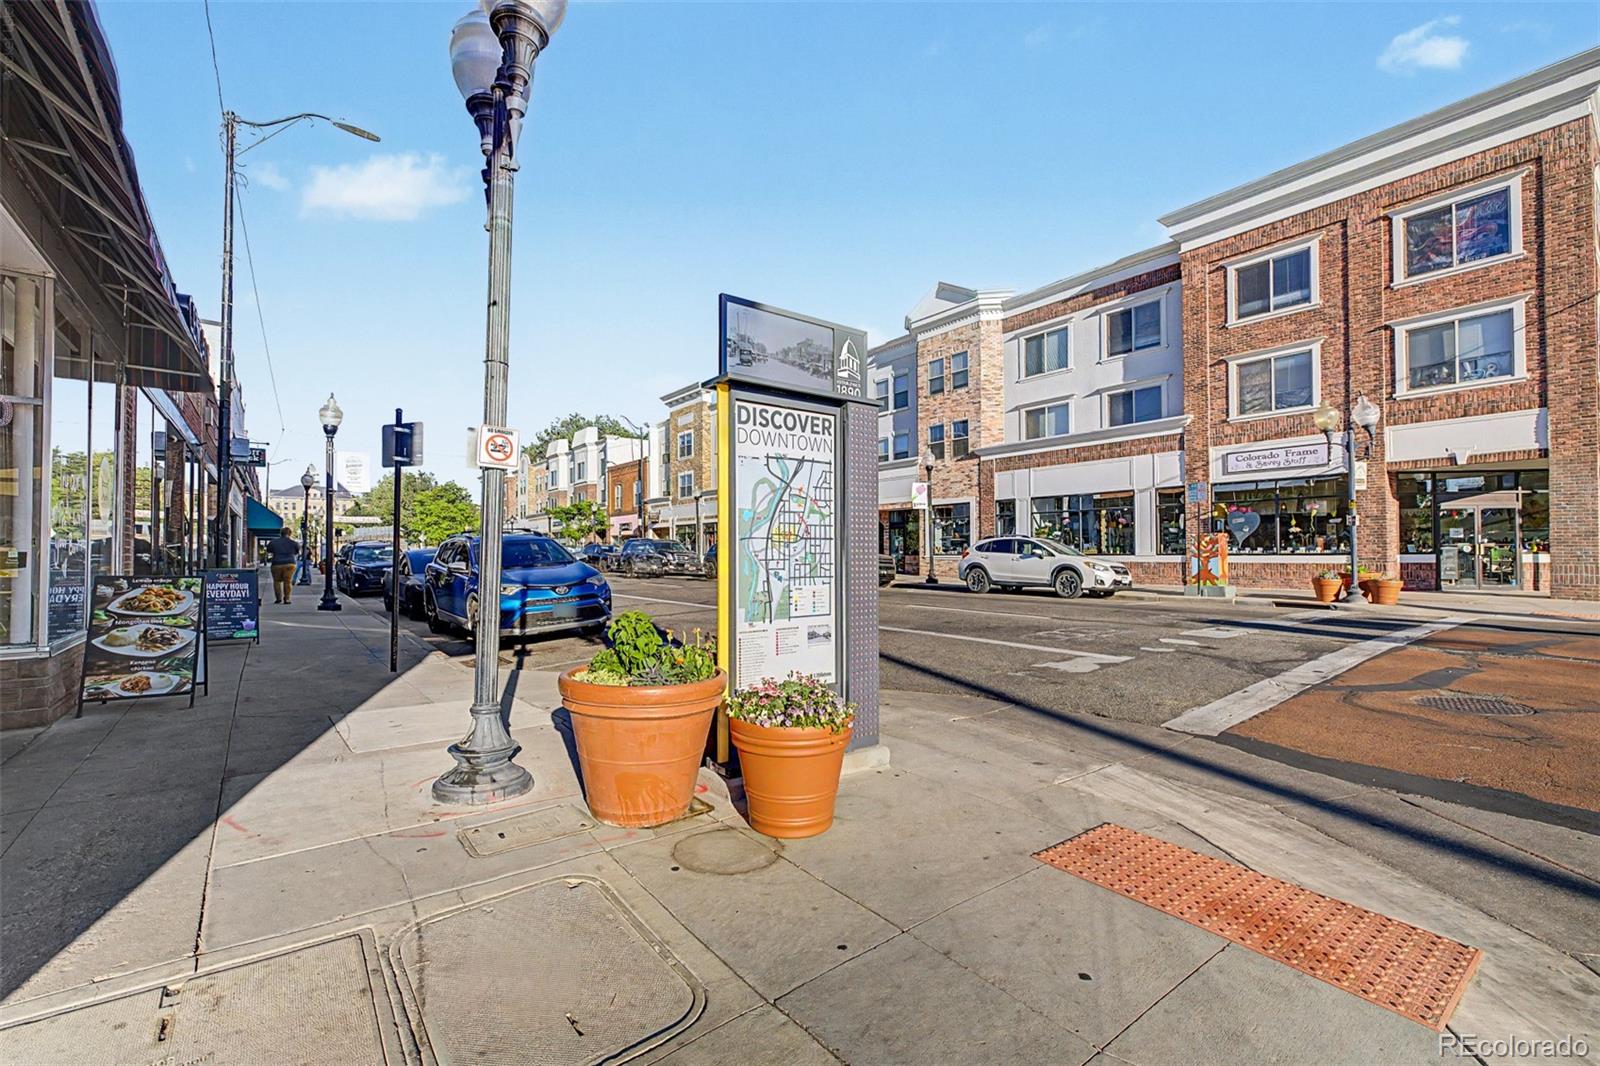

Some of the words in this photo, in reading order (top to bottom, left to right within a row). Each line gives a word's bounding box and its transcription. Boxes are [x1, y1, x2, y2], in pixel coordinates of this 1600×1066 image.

[836, 384, 861, 398] 1890
[737, 405, 832, 437] DISCOVER
[737, 427, 832, 454] DOWNTOWN
[1235, 450, 1280, 463] Colorado
[1285, 447, 1319, 457] Frame
[206, 589, 250, 598] EVERYDAY!
